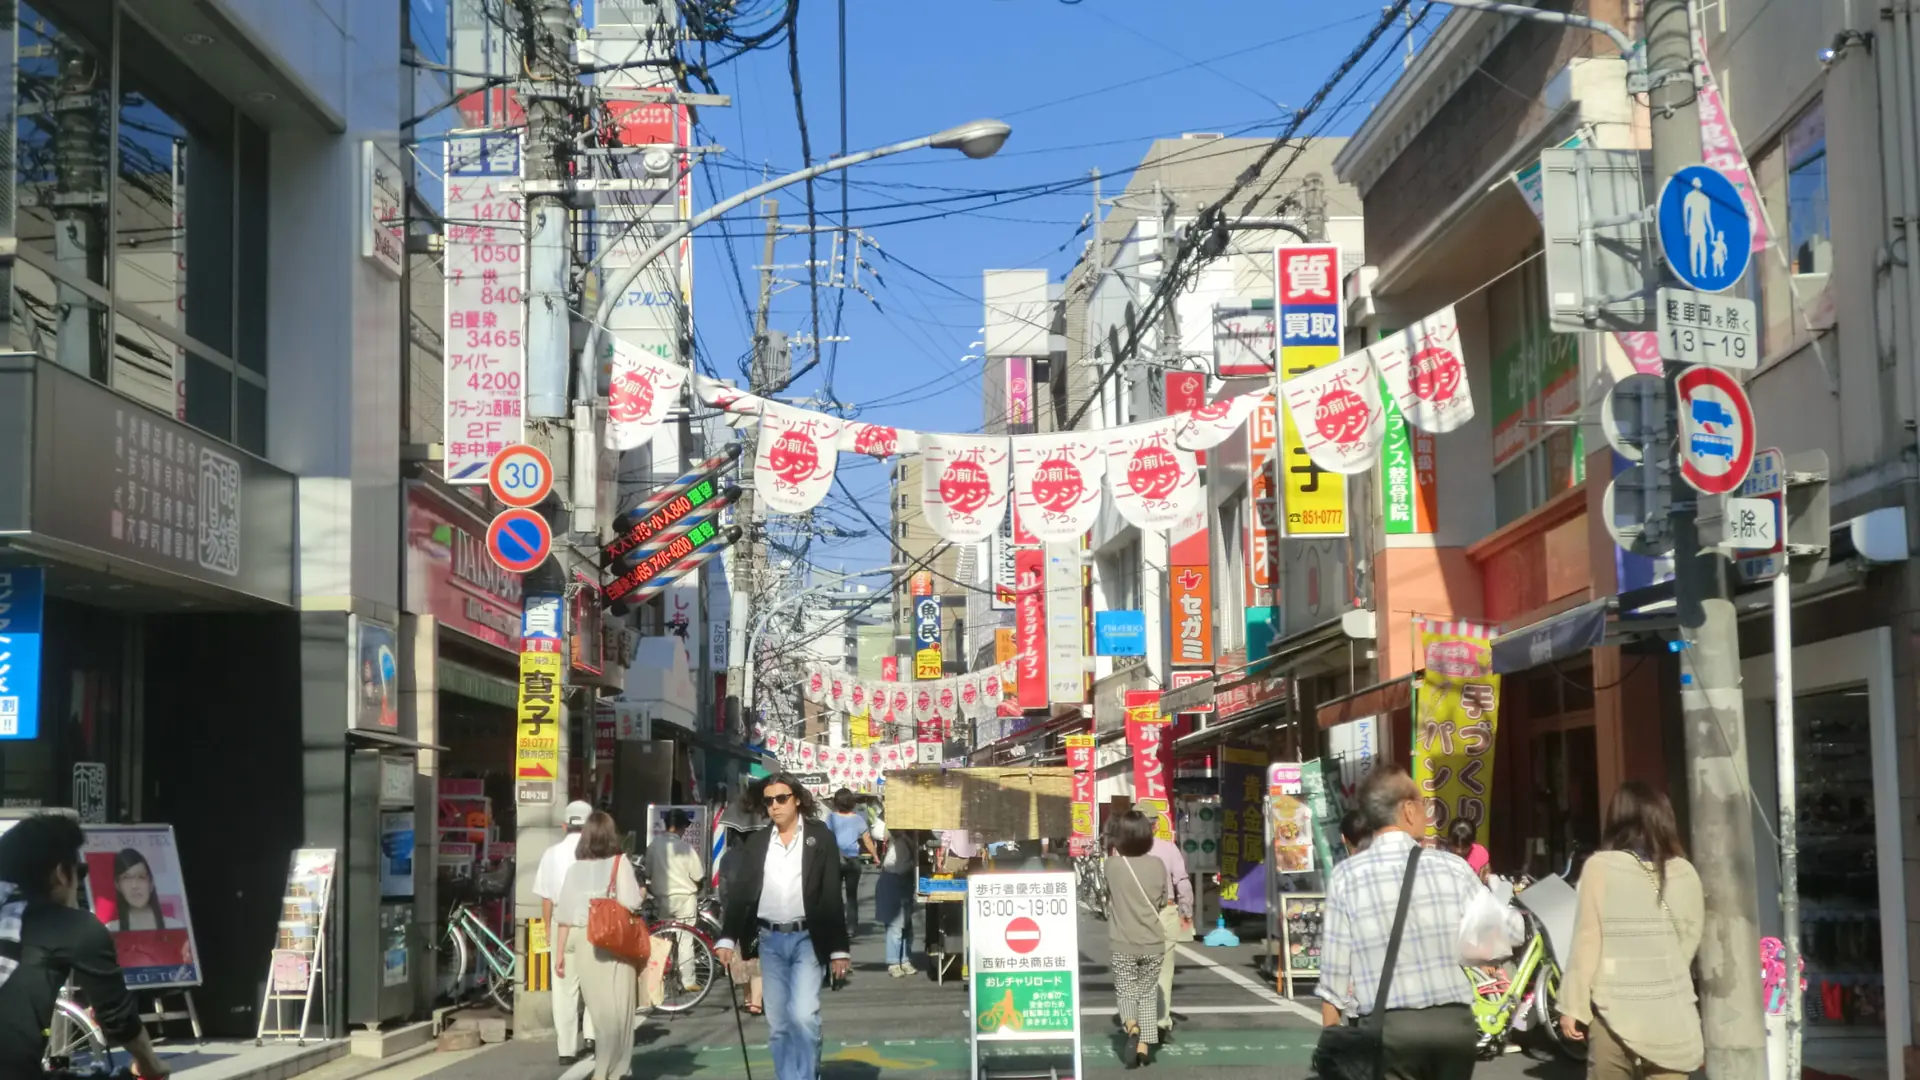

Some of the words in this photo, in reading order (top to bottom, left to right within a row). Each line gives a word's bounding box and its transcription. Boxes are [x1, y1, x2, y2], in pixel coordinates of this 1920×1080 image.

[450, 137, 518, 172] 理容
[450, 183, 494, 201] 大人
[472, 203, 520, 221] 1470
[449, 226, 496, 243] 中学生
[472, 245, 520, 264] 1050
[451, 269, 498, 286] 子供
[1287, 254, 1330, 297] 質
[480, 286, 520, 305] 840
[1284, 312, 1337, 339] 買取
[1667, 299, 1750, 331] 軽車両を除く
[467, 329, 521, 348] 3465
[1379, 322, 1460, 372] ニッポン
[450, 353, 500, 370] アイパー
[611, 349, 680, 391] ニッポン
[1408, 349, 1453, 380] の前に
[467, 371, 521, 391] 4200
[612, 374, 655, 402] の前に
[1289, 365, 1371, 408] ニッポン
[1314, 393, 1363, 420] の前に
[467, 421, 502, 439] 2F
[762, 413, 840, 440] ニッポン
[1305, 406, 1383, 450] ニシジン
[772, 436, 819, 455] の前に
[925, 444, 1009, 466] ニッポン
[1015, 443, 1099, 464] ニッポン
[755, 454, 833, 482] ニシジン
[1127, 451, 1179, 472] の前に
[504, 462, 539, 489] 30
[942, 468, 990, 483] の前に
[1033, 468, 1082, 483] の前に
[1115, 471, 1199, 499] ニシジン
[772, 479, 806, 498] やろ。
[924, 485, 1007, 508] ニシジン
[1016, 485, 1101, 508] ニシジン
[1140, 496, 1179, 513] やろ。
[946, 510, 982, 526] やろ。
[1041, 510, 1078, 525] やろ。
[1303, 510, 1343, 526] 851-0777
[920, 602, 938, 641] 魚民
[1180, 593, 1203, 661] セガミ
[525, 639, 554, 653] 買取
[1021, 593, 1039, 679] ドラッグイレブン
[919, 665, 941, 676] 270
[520, 669, 556, 736] 真子
[1069, 737, 1092, 747] 本日
[1139, 723, 1167, 797] ポイント
[1459, 684, 1496, 830] 手づくり
[1073, 747, 1090, 801] ポイント
[1071, 802, 1093, 837] 5
[975, 882, 1068, 897] 歩行者優先道路
[982, 957, 1066, 969] 西新中央商店街
[985, 976, 1063, 988] おしチャリロード
[1025, 1017, 1069, 1027] 歩きましょう
